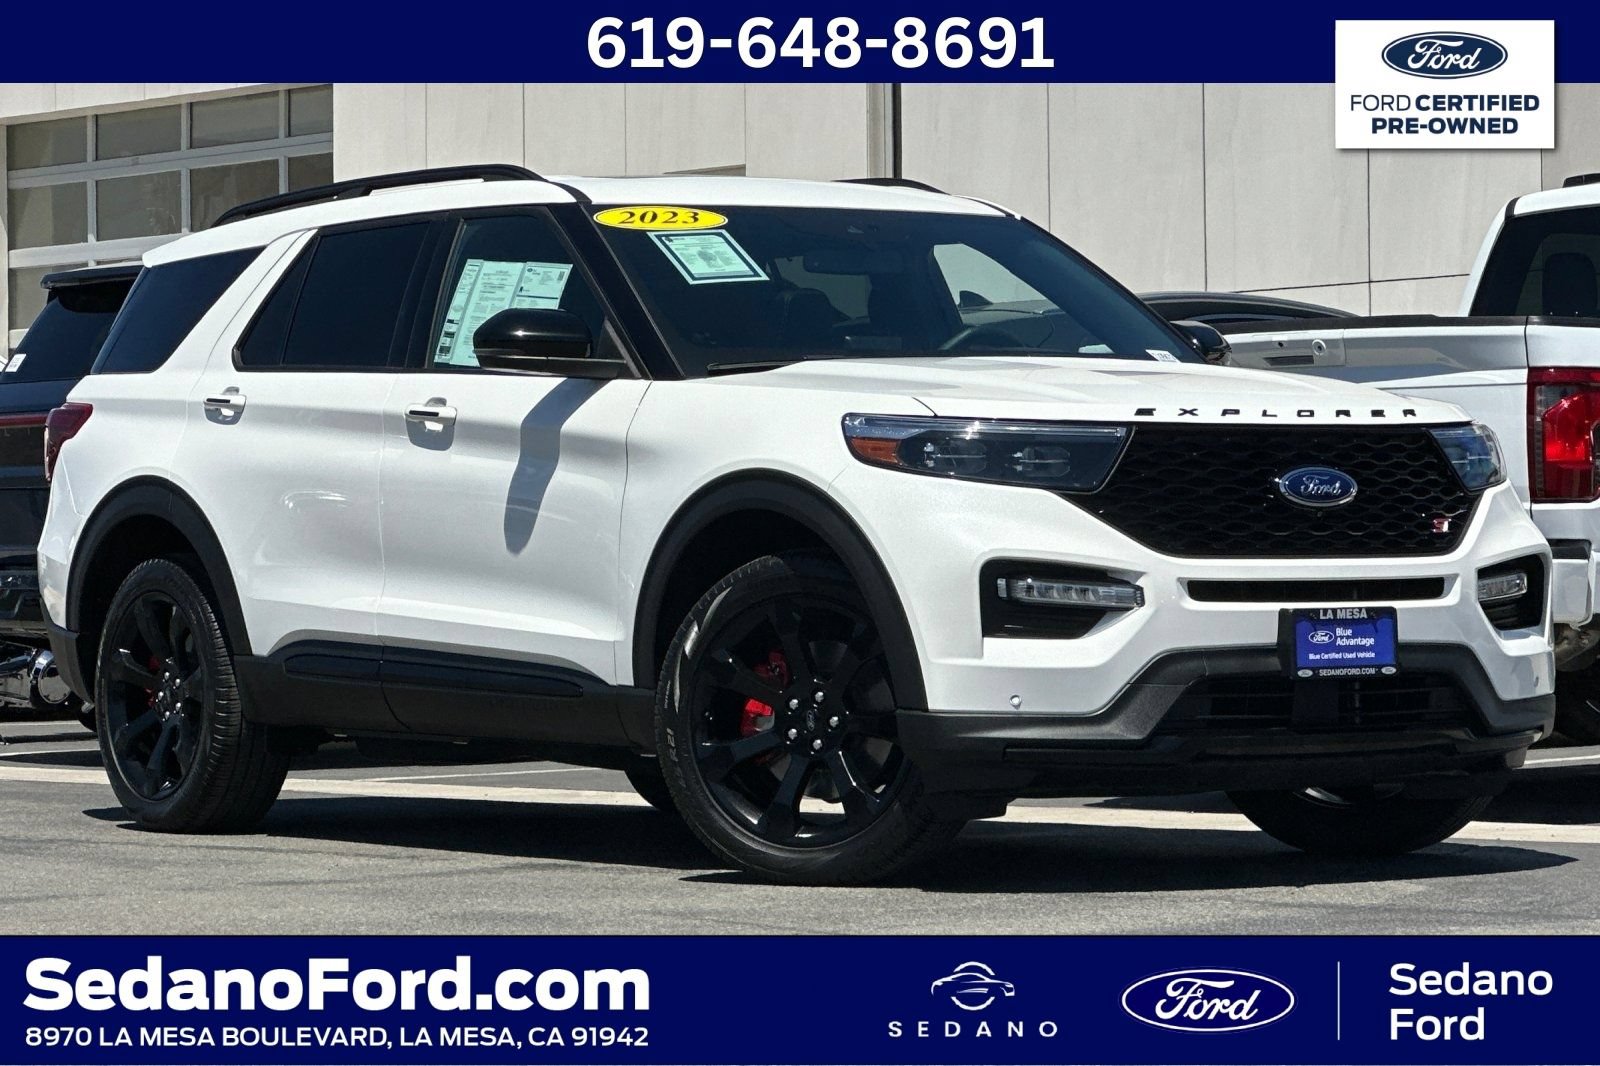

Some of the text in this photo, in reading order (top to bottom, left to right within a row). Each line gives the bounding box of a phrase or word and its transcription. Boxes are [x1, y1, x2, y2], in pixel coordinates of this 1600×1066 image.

[617, 210, 700, 225] 2023
[1134, 407, 1417, 418] EXPLORER
[1300, 474, 1342, 496] Ford
[1319, 607, 1368, 620] LA MESA
[1335, 627, 1353, 637] Blue
[1335, 636, 1376, 647] Advantage
